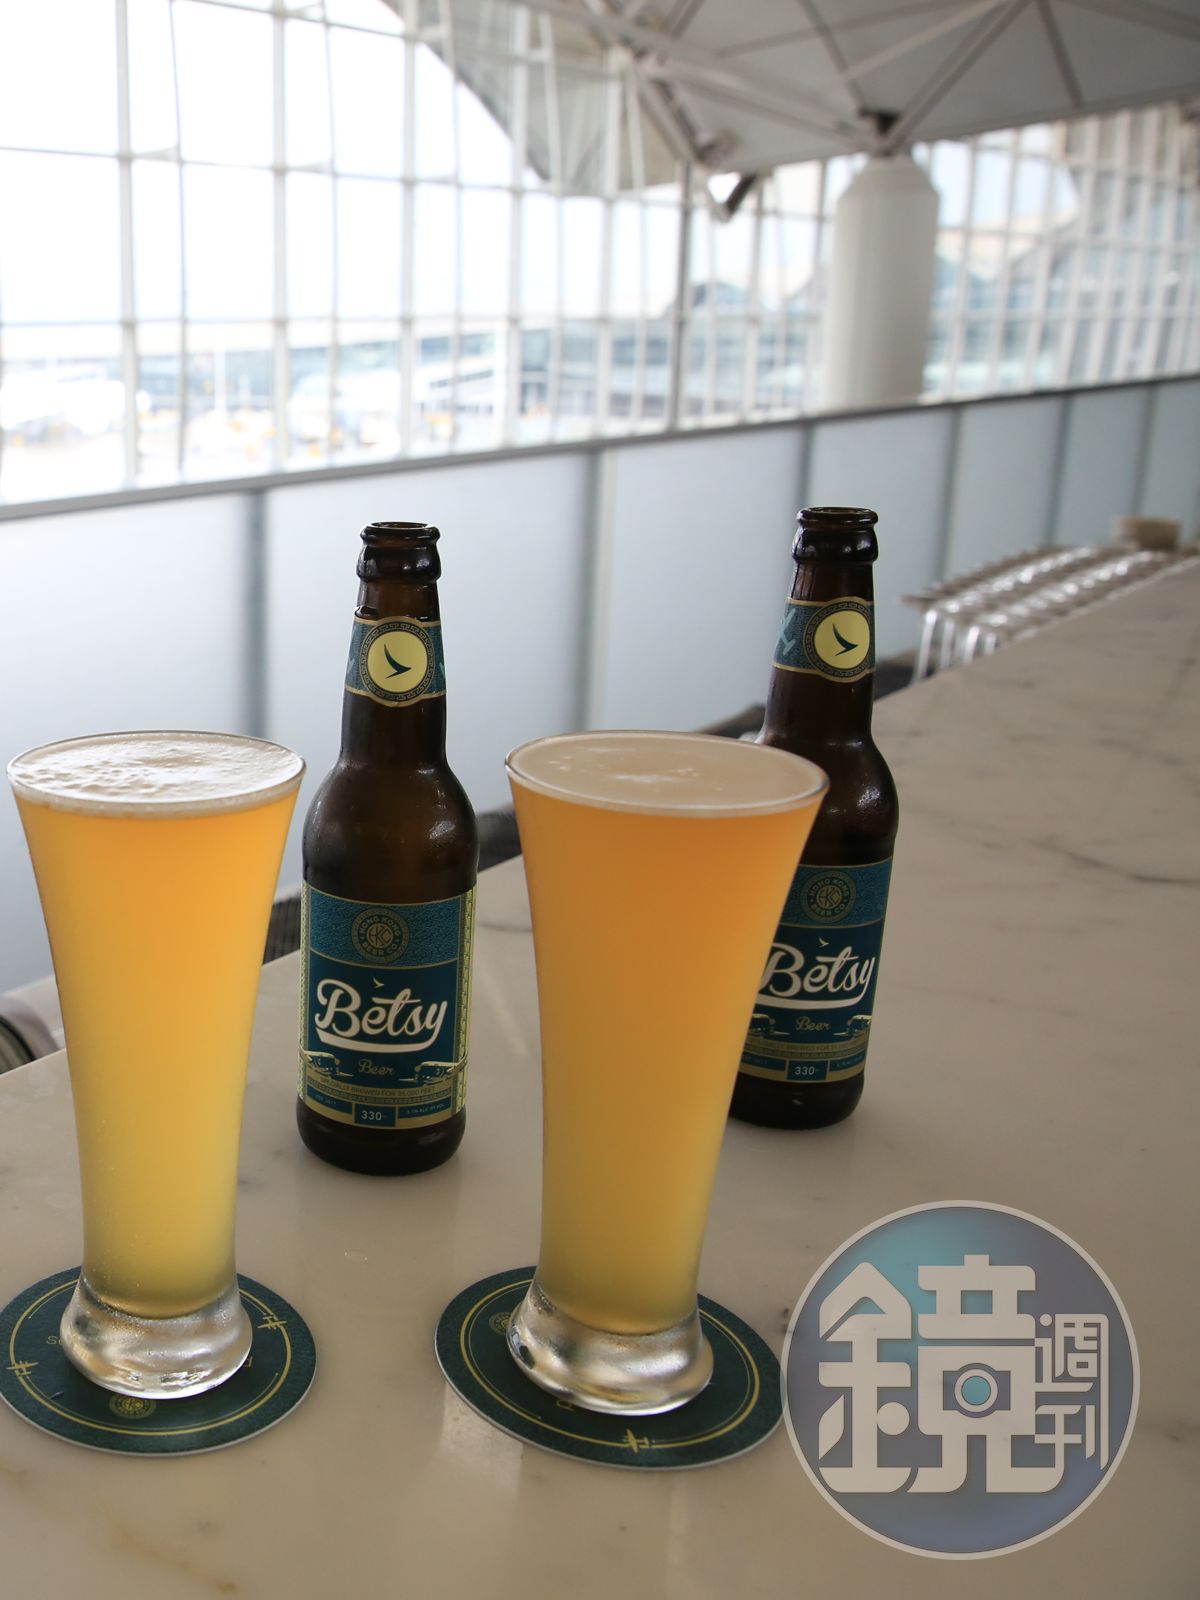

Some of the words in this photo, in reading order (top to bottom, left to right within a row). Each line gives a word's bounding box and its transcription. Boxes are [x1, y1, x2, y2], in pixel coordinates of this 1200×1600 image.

[759, 942, 876, 1009] Betsy
[314, 978, 448, 1053] Betsy
[795, 1016, 830, 1031] Beer
[358, 1059, 395, 1076] Beer
[794, 1065, 815, 1076] 330
[361, 1110, 382, 1121] 330
